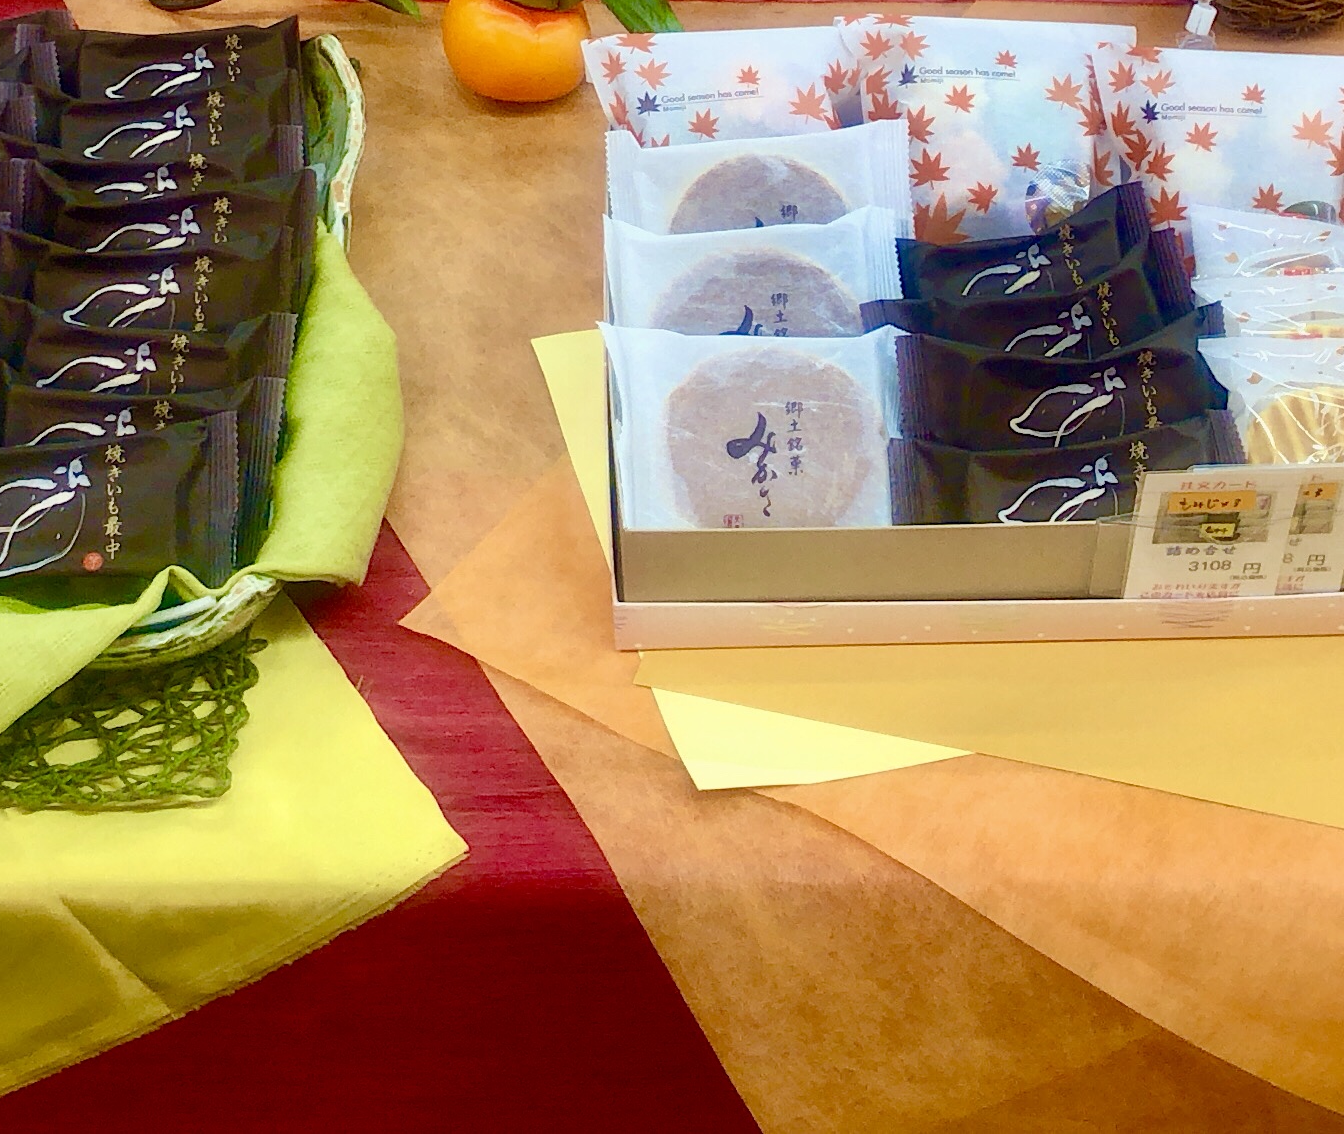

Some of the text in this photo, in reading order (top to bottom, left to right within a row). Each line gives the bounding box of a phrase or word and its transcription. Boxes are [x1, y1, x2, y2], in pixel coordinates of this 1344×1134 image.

[785, 400, 804, 476] 郷土銘菓
[103, 444, 127, 561] 焼きいも最中
